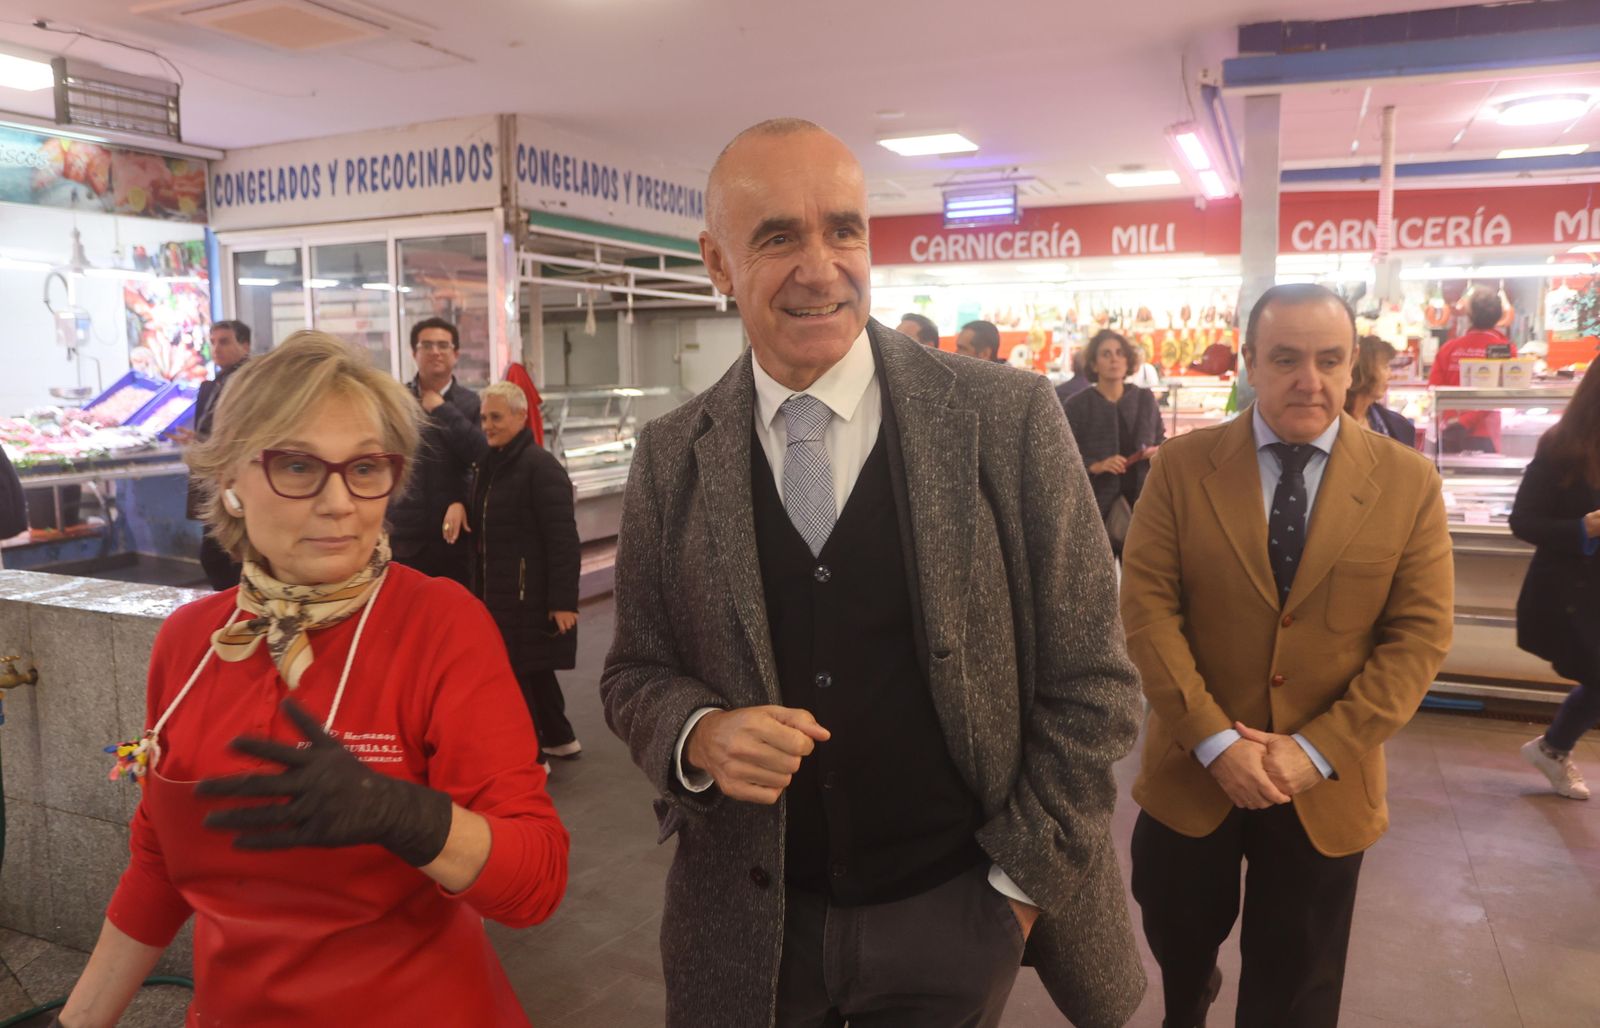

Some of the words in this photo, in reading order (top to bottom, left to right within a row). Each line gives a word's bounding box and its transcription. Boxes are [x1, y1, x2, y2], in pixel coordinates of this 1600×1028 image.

[214, 163, 320, 207] CONGELADOS
[328, 158, 338, 196] Y
[346, 142, 493, 195] PRECOCINADOS
[517, 143, 618, 202] CONGELADOS
[623, 170, 632, 204] Y
[910, 223, 1081, 262] CARNICERÍA
[1112, 223, 1175, 254] MILI
